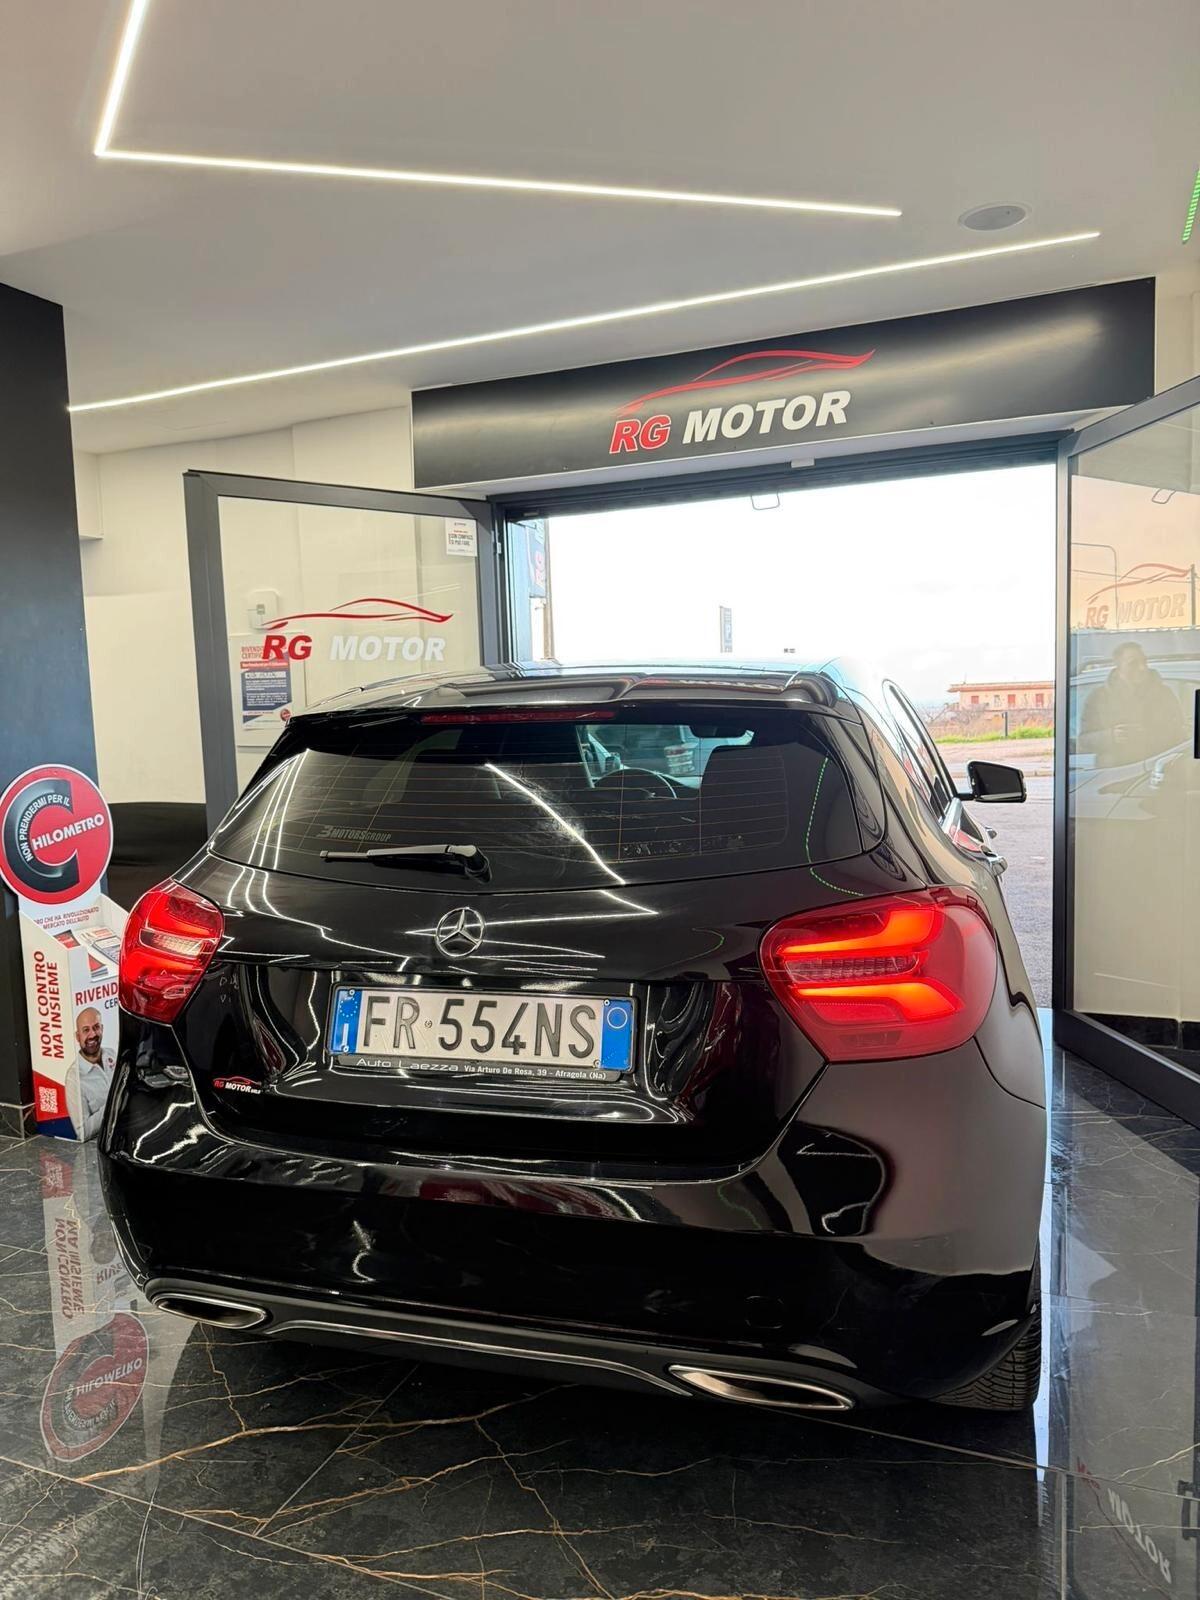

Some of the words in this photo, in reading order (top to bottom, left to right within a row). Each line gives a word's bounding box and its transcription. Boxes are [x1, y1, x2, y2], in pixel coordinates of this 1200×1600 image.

[609, 414, 672, 454] RG
[682, 390, 851, 444] MOTOR
[1086, 605, 1109, 628] RG
[1118, 593, 1187, 624] MOTOR
[262, 635, 312, 660] RG
[330, 635, 446, 662] MOTOR
[47, 794, 62, 804] PER
[63, 797, 71, 806] IL
[19, 796, 47, 841] PRENDERMI
[20, 842, 34, 862] NON
[43, 920, 65, 929] MERCATO
[44, 916, 54, 924] CHE
[34, 950, 50, 1016] CONTRO
[47, 962, 62, 1028] INSIEME
[75, 982, 119, 1006] RIVEND
[104, 998, 119, 1009] CER
[363, 995, 421, 1050] FR
[438, 998, 597, 1058] 554NS
[39, 1021, 52, 1057] NON
[52, 1034, 64, 1059] MA
[356, 1058, 392, 1068] Auto
[399, 1060, 459, 1071] Laezza
[464, 1065, 476, 1073] Via
[477, 1066, 501, 1074] Arturo
[502, 1067, 513, 1075] De
[537, 1068, 547, 1076] 39
[555, 1069, 587, 1079] Afragola
[589, 1071, 607, 1080] (Na)
[225, 1082, 252, 1093] MOTOR
